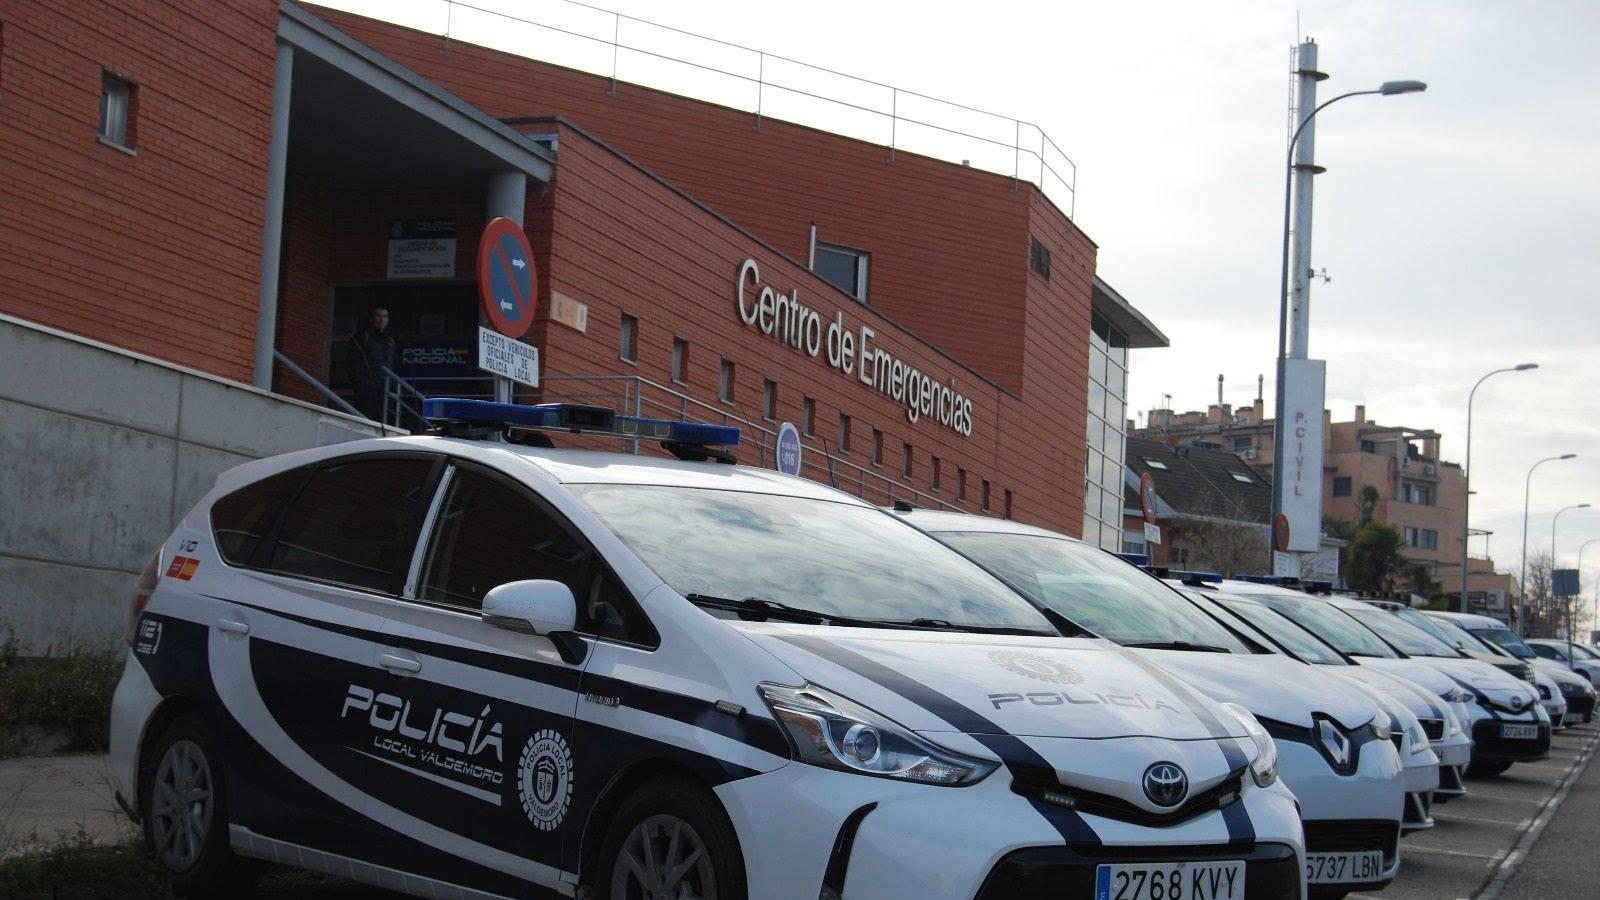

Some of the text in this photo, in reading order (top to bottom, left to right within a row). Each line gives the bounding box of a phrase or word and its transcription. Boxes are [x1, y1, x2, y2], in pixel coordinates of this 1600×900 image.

[402, 356, 466, 365] NACIONAL
[482, 331, 535, 361] EXCEPTO VEHICULOS
[487, 345, 528, 370] OFICIALES DE
[736, 258, 972, 437] Centro de Emergencias
[486, 357, 532, 383] POLICIA LOCAL
[341, 683, 503, 762] POLICÍA
[374, 735, 503, 785] LOCAL VALDEMORO
[527, 742, 565, 779] POLICIA LOCAL
[528, 794, 560, 818] VALDEMORO
[1306, 854, 1380, 881] 5737 LBN
[1114, 866, 1238, 900] 2768 KVY
